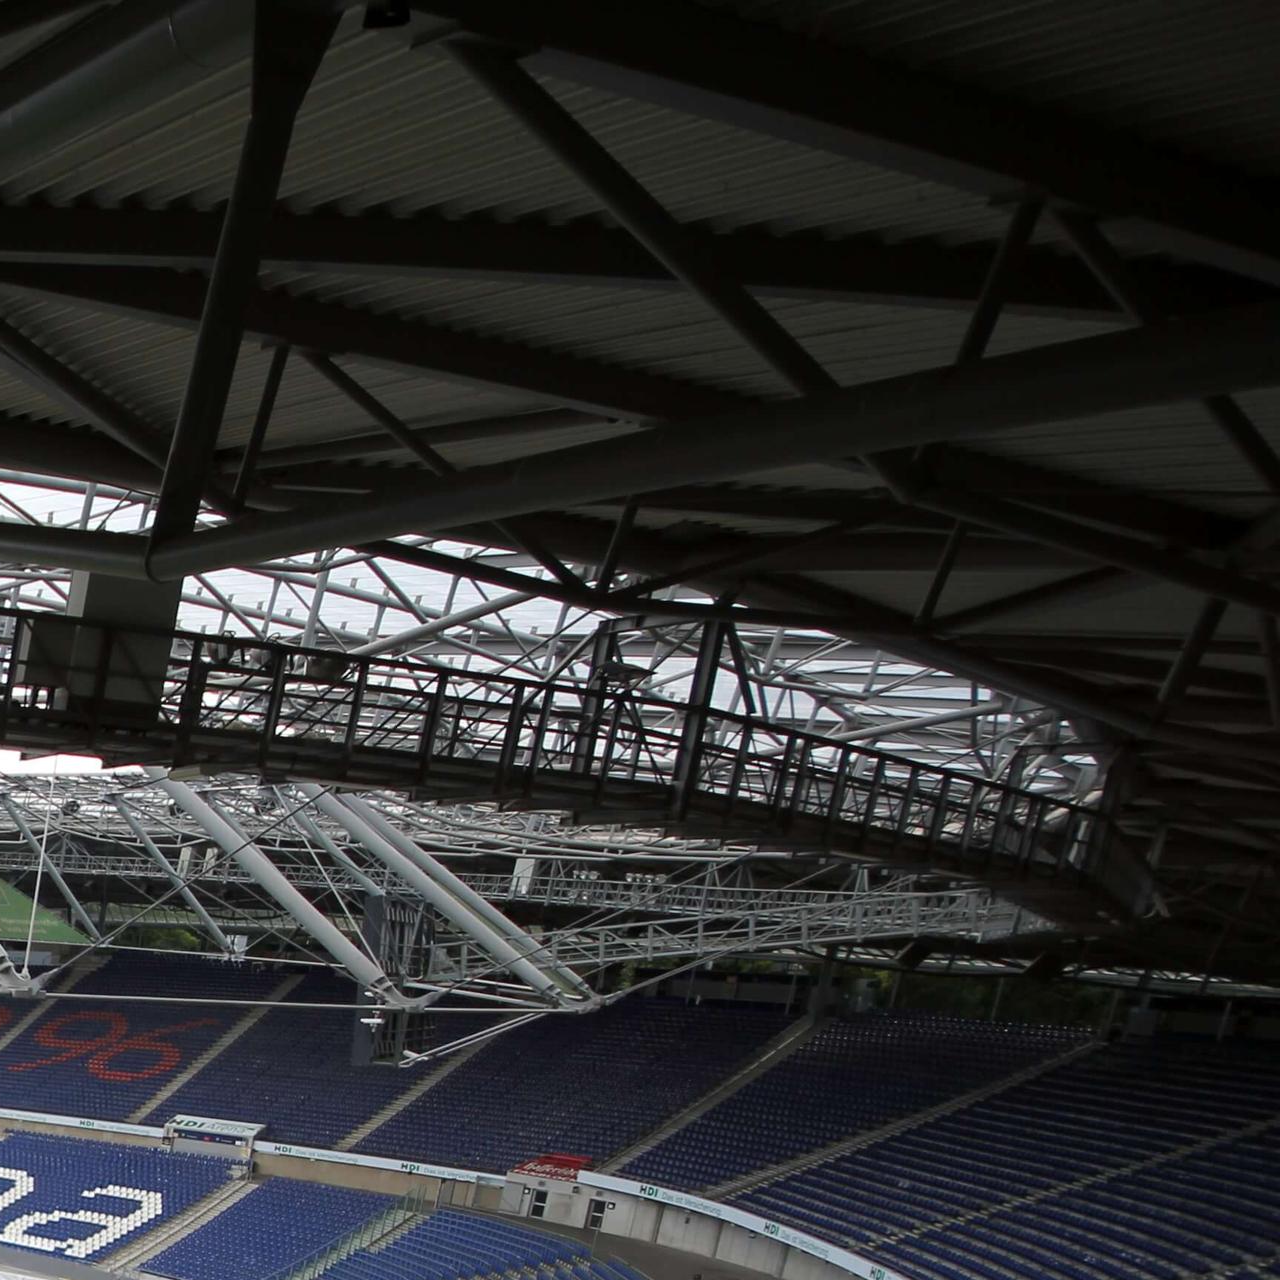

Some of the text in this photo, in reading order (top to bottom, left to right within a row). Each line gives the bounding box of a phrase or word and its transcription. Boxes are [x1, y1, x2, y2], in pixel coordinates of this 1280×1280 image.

[7, 1011, 220, 1082] 96
[80, 1119, 95, 1127] HDI
[169, 1119, 205, 1129] HDI
[274, 1145, 292, 1154] HDI
[401, 1163, 419, 1172] HDI
[640, 1185, 658, 1197] HDI
[764, 1222, 780, 1236] HDI
